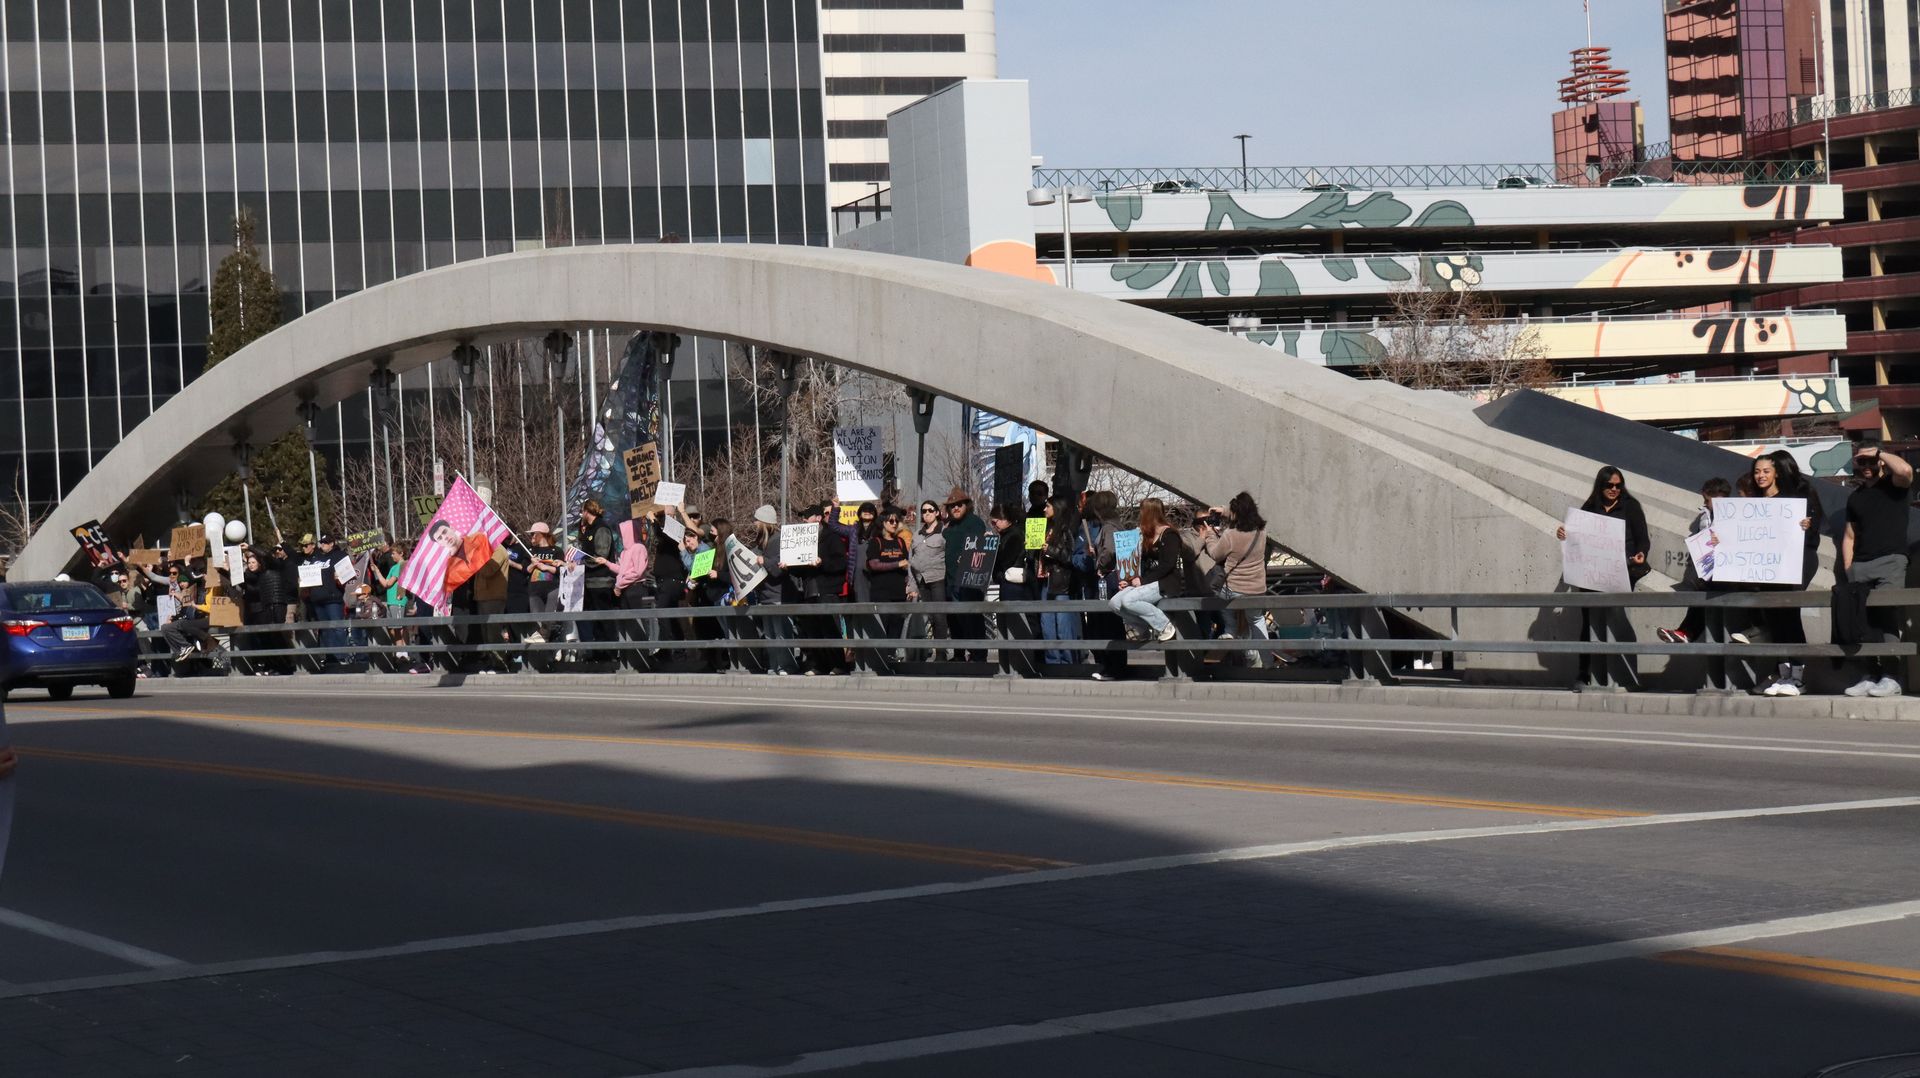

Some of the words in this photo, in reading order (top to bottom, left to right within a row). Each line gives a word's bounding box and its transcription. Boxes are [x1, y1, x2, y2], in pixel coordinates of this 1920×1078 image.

[836, 429, 846, 437] WE
[850, 428, 864, 436] ARE
[836, 436, 873, 446] ALWAYS
[626, 450, 655, 467] WRONG
[837, 455, 877, 465] NATION
[630, 462, 654, 481] ICE
[837, 469, 883, 481] IMMIGRANTS
[1715, 502, 1735, 518] NO
[1742, 502, 1772, 519] ONE
[1780, 504, 1793, 519] IS
[79, 525, 108, 548] ICE
[348, 533, 364, 542] STAY
[1737, 525, 1776, 541] ILLEGAL
[983, 536, 998, 550] ICE
[971, 552, 986, 568] NOT
[1716, 552, 1732, 567] ON
[1735, 551, 1781, 566] STOLEN
[729, 548, 761, 590] ICE
[1741, 568, 1776, 581] LAND
